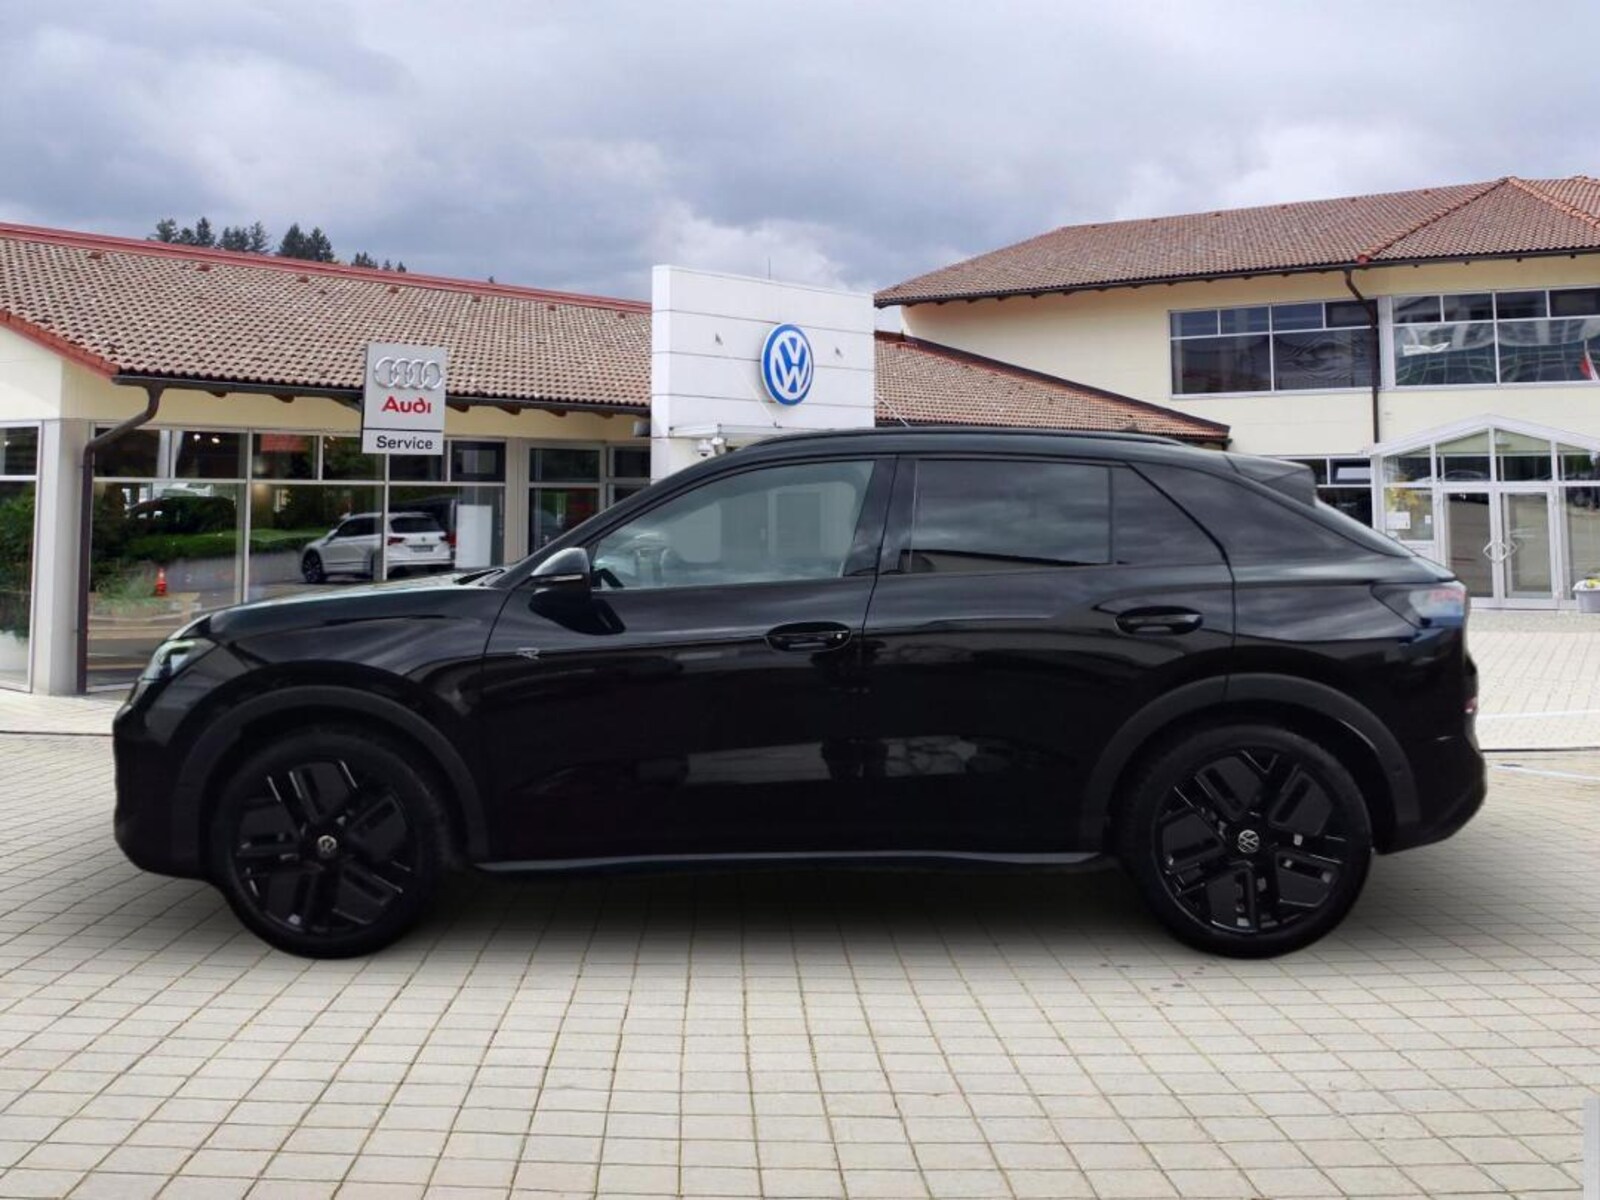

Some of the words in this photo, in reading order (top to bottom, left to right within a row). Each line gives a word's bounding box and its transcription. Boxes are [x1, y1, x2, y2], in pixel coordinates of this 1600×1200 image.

[768, 329, 811, 400] VW
[381, 396, 432, 414] Audi
[376, 435, 434, 450] Service
